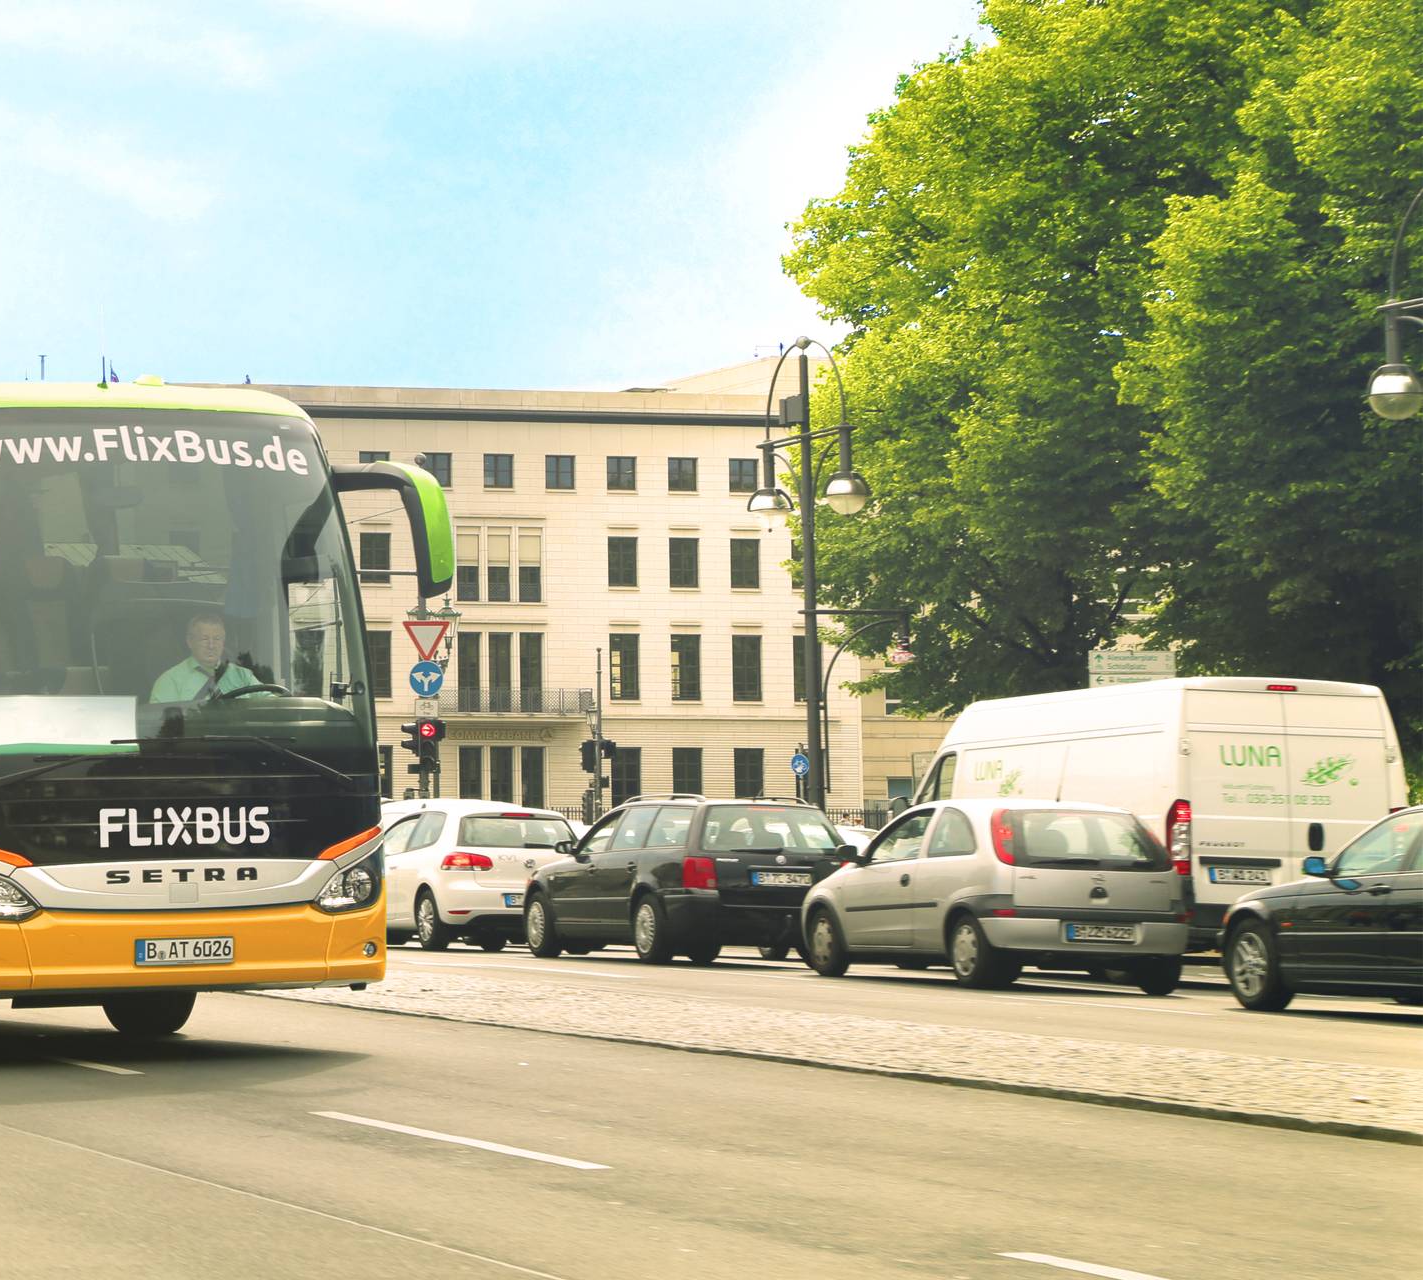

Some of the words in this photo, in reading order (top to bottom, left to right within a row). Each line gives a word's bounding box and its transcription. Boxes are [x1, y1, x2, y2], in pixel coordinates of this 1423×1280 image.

[1219, 744, 1282, 767] LUNA
[106, 867, 258, 885] SETRA
[146, 942, 157, 959] B
[169, 941, 189, 959] AT
[193, 940, 232, 958] 6026
